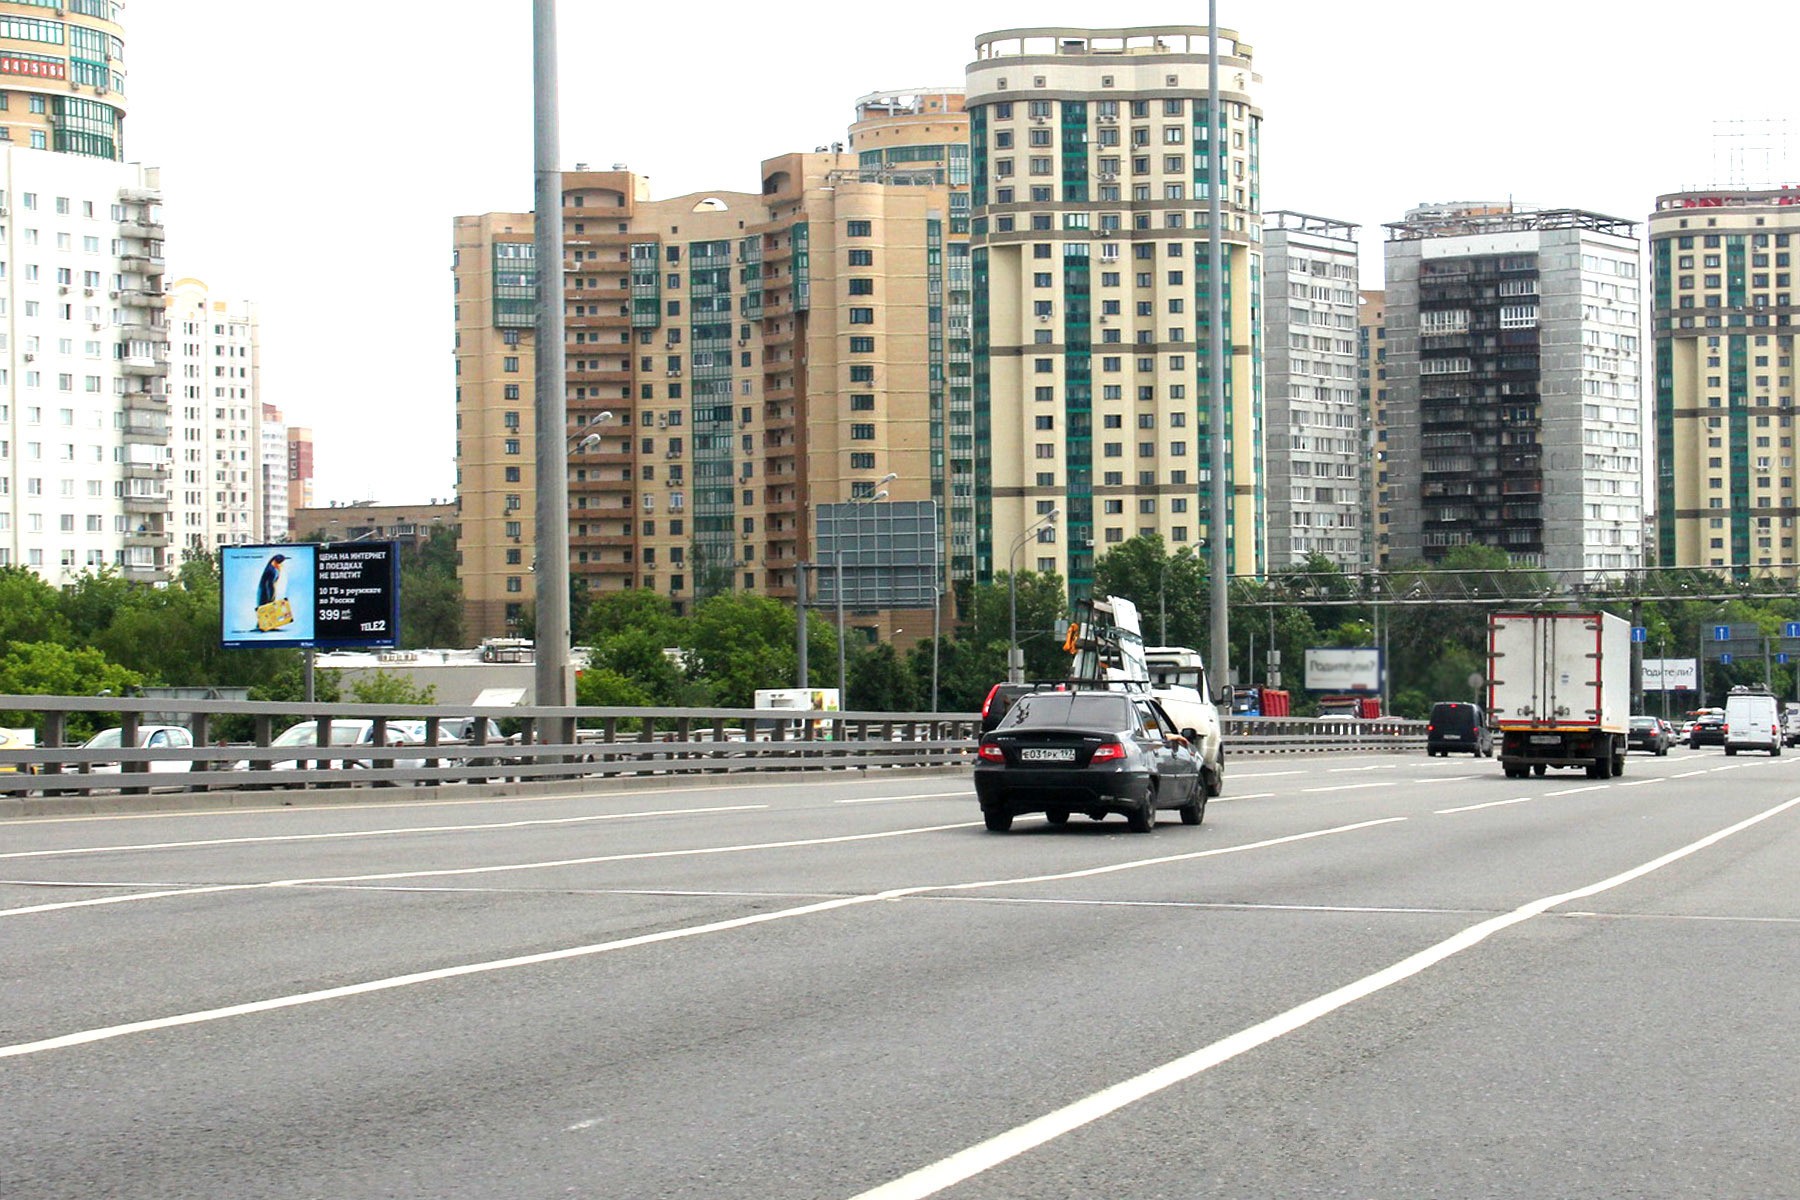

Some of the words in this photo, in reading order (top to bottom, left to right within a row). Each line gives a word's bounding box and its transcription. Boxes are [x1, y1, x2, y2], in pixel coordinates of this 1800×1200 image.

[319, 562, 324, 570] В
[326, 562, 363, 570] ПОЕЗДКАХ
[330, 571, 361, 579] ВЗЛЕТИТ
[319, 609, 340, 620] 399
[360, 620, 386, 631] TELE2
